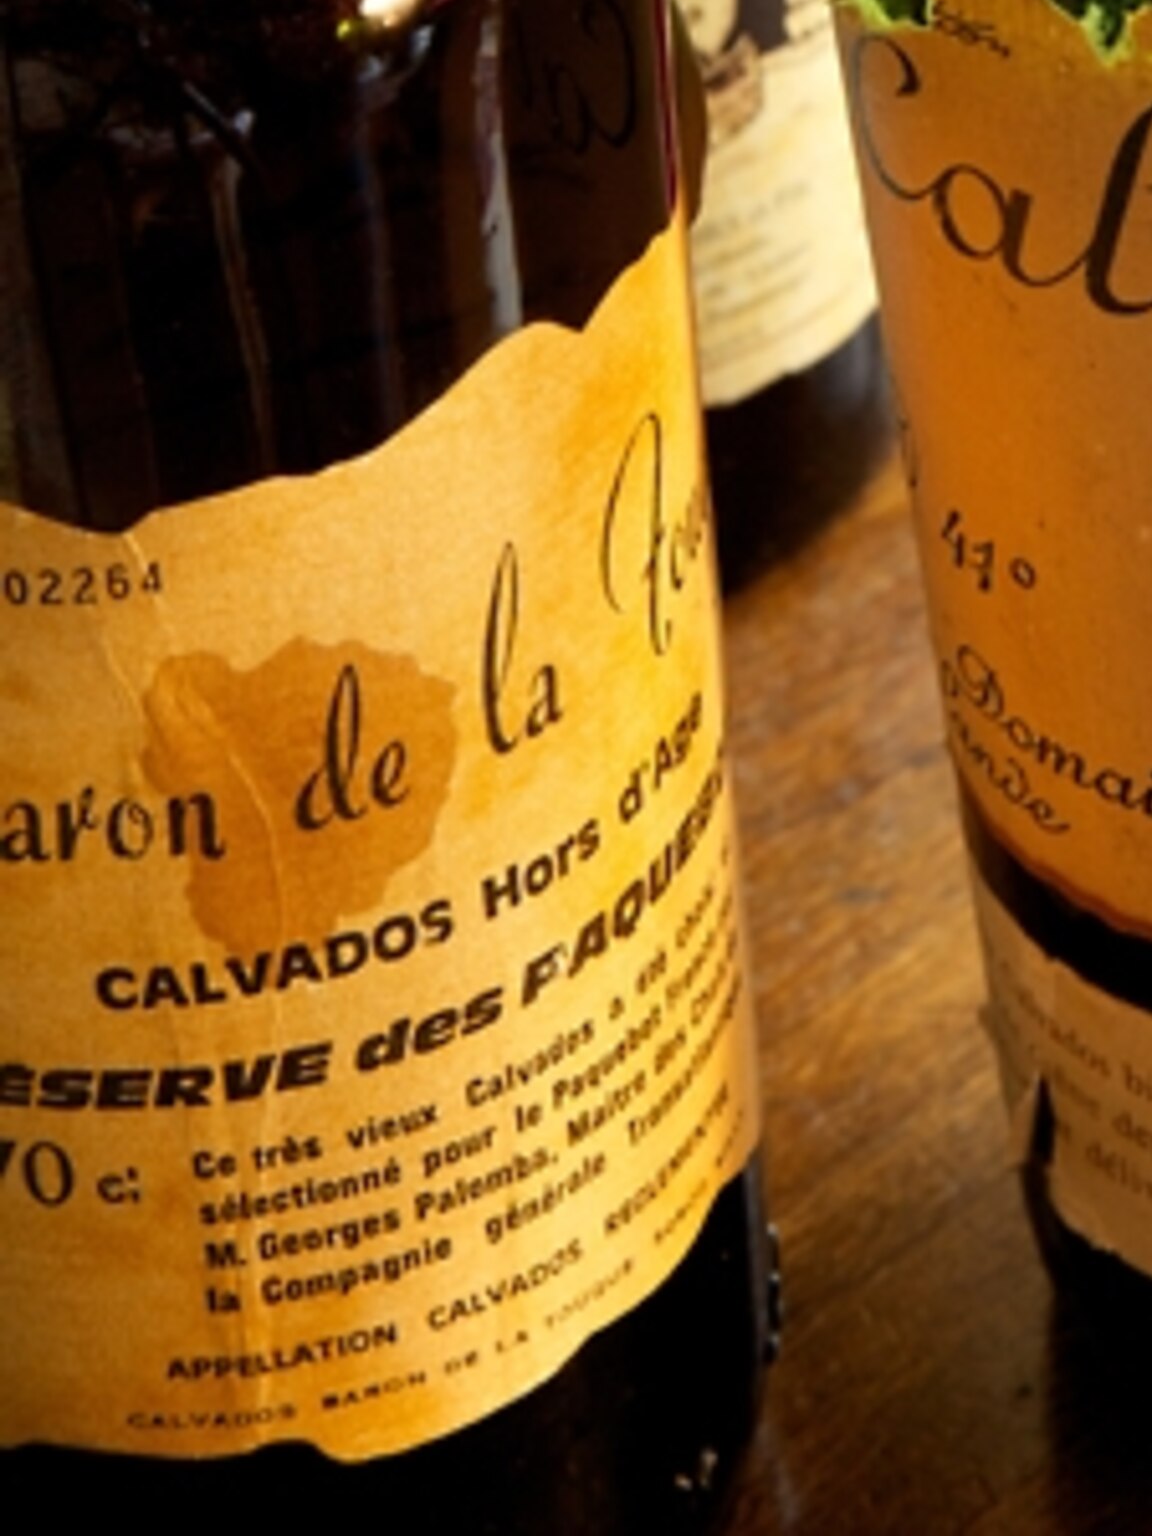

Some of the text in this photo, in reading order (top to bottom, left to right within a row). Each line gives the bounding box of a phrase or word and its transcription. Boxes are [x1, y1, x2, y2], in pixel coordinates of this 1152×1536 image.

[293, 665, 407, 831] de
[481, 540, 563, 755] la
[95, 897, 453, 1011] CALVADOS
[480, 817, 601, 921] Hors
[191, 1149, 237, 1181] Ce
[250, 1133, 324, 1173] très
[345, 1101, 440, 1151] vieux
[464, 1016, 596, 1109] Calvados
[354, 985, 504, 1075] des
[199, 1157, 402, 1226] sélectionné
[422, 1124, 498, 1179] pour
[514, 1103, 543, 1133] le
[165, 1322, 398, 1382] APPELLATION
[426, 1237, 585, 1333] CALVADOS
[206, 1288, 242, 1315] la
[261, 1234, 454, 1307] Compagnie
